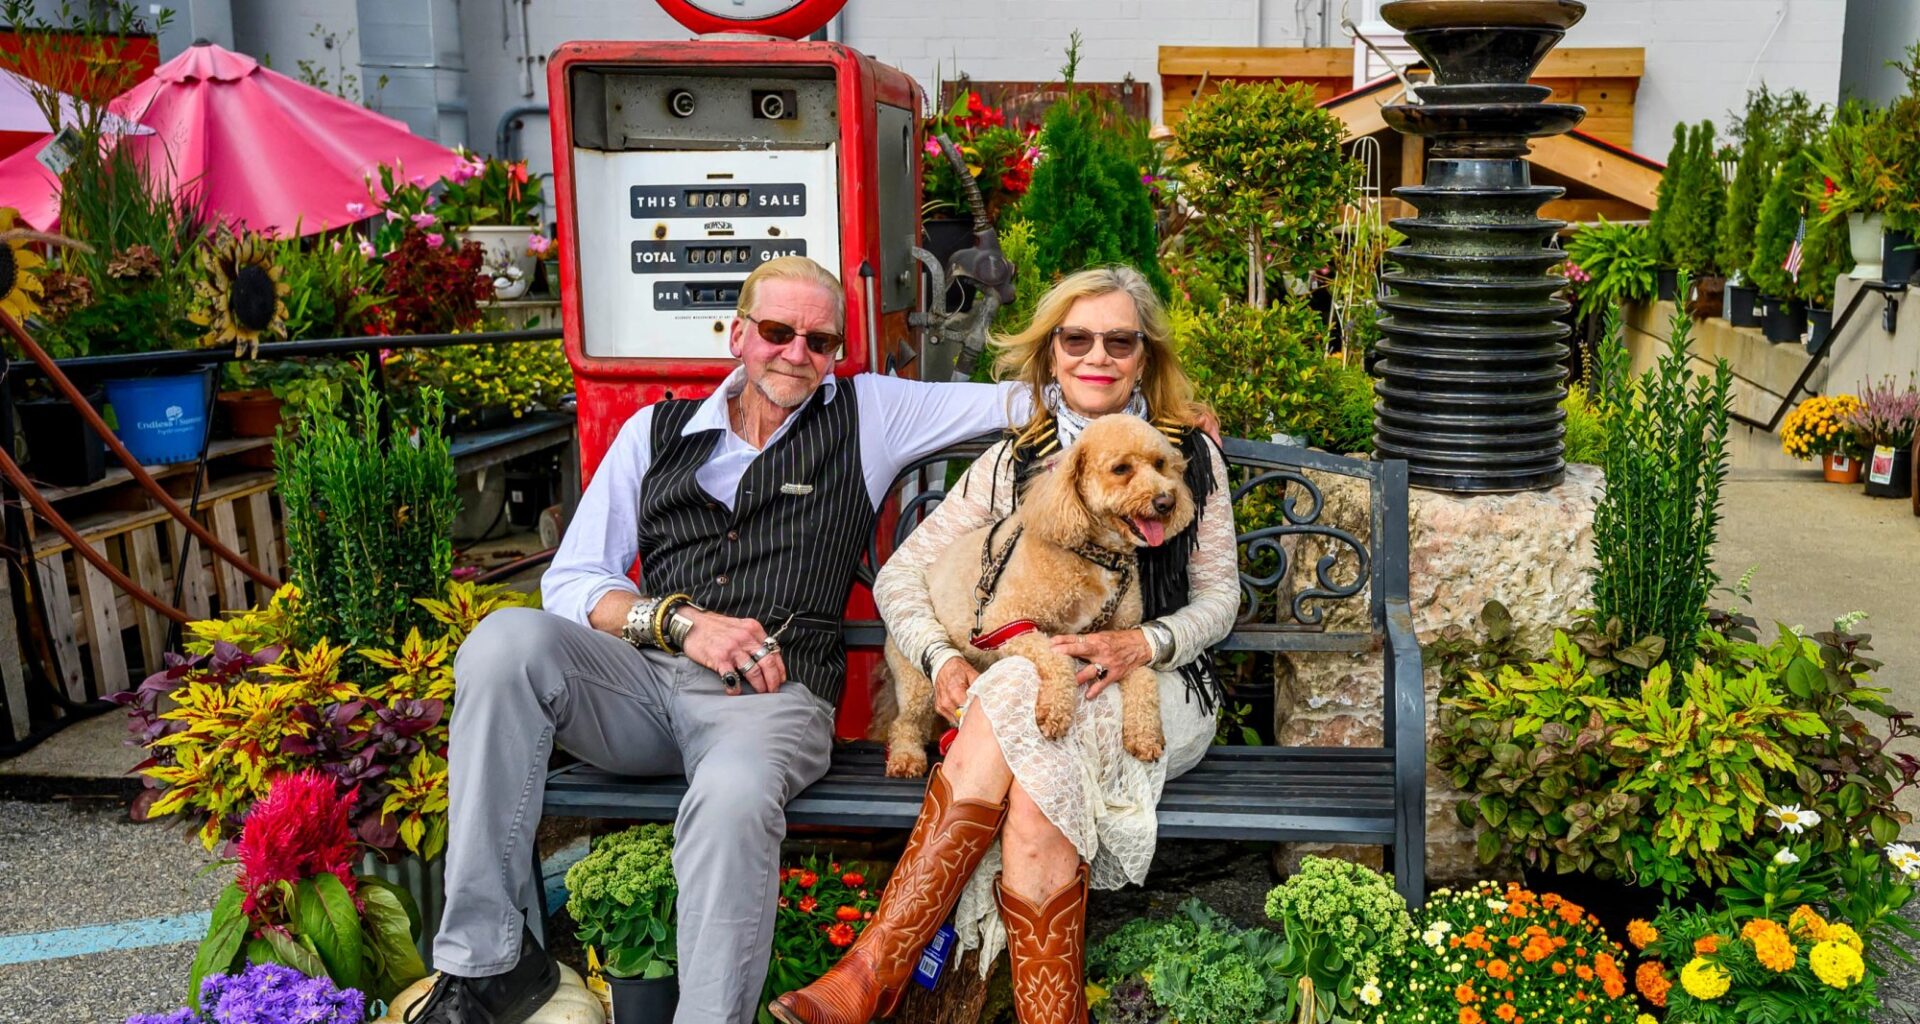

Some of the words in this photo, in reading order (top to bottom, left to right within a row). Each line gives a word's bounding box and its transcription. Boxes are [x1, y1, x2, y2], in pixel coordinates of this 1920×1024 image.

[637, 196, 677, 208] THIS
[759, 194, 800, 206] SALE
[636, 252, 676, 263] TOTAL
[658, 292, 679, 300] PER
[137, 420, 173, 430] Endless
